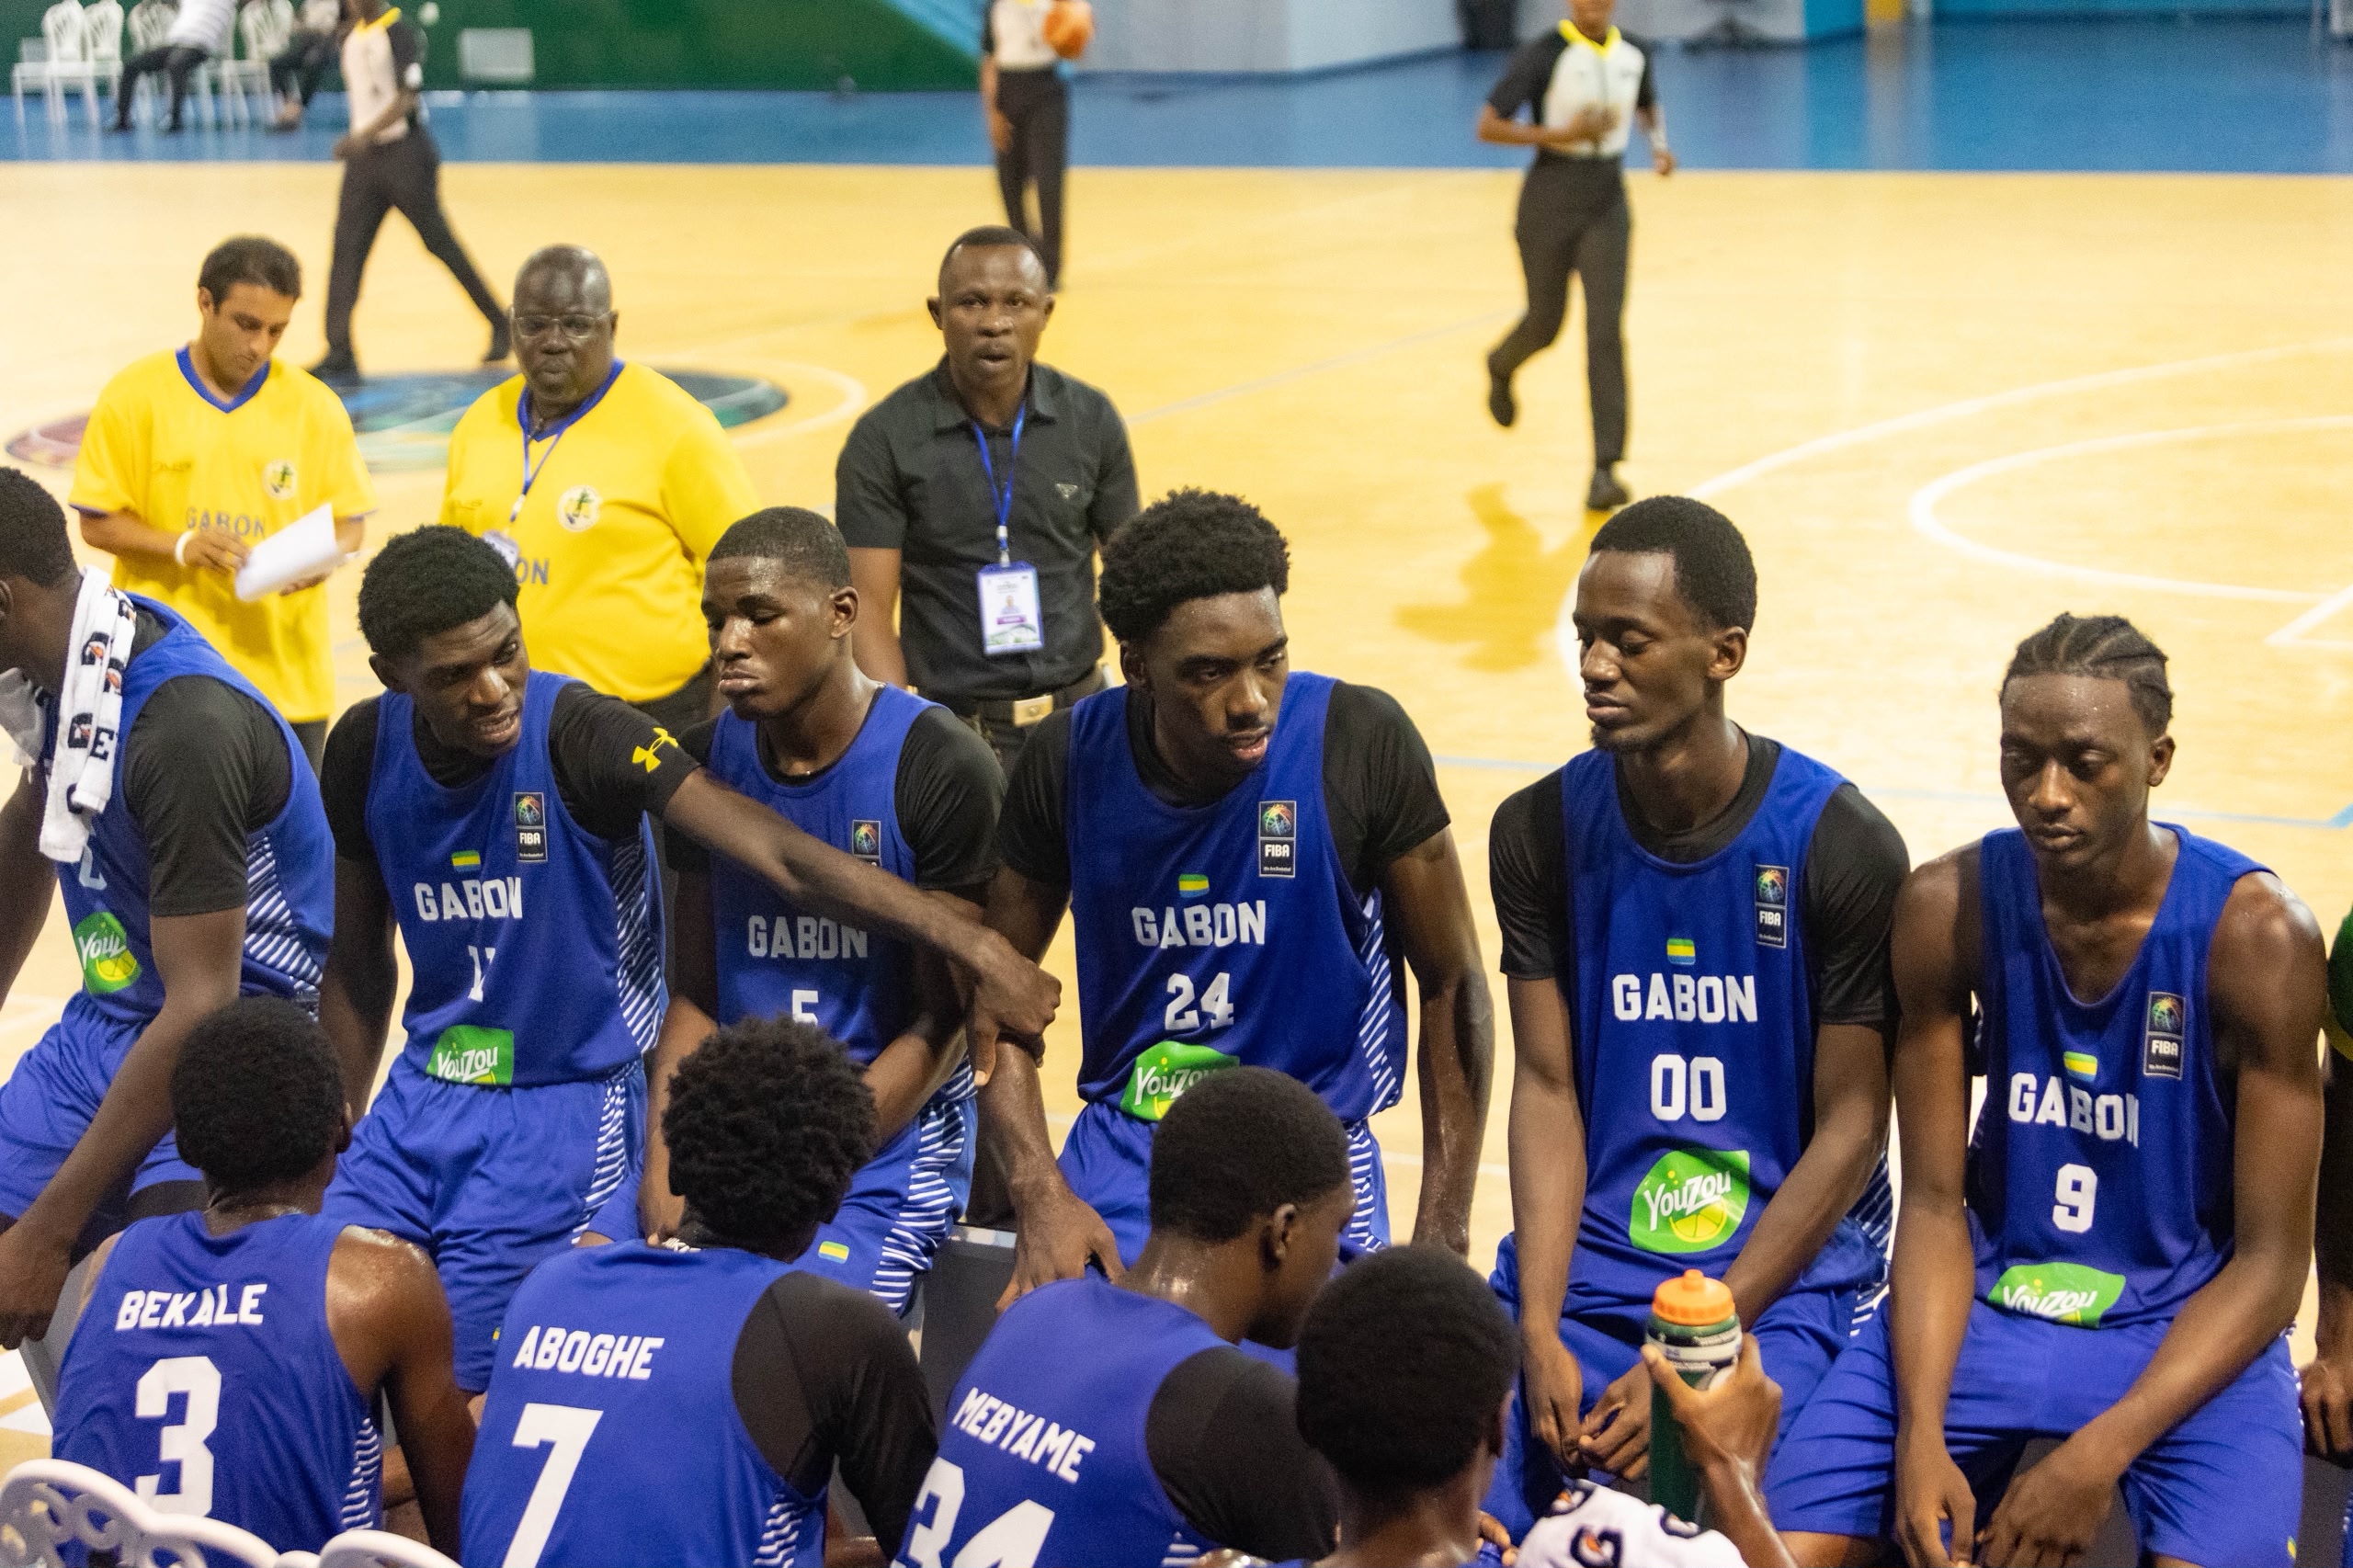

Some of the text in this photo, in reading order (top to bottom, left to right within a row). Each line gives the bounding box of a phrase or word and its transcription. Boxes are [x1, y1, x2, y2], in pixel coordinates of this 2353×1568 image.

[186, 506, 266, 538] GABON
[519, 832, 541, 845] FIBA
[1265, 844, 1290, 858] FIBA
[414, 877, 523, 921] GABON
[1759, 910, 1781, 926] FIBA
[748, 915, 869, 960] GABON
[1131, 900, 1266, 949] GABON
[791, 989, 819, 1026] 5
[1165, 971, 1234, 1030] 24
[1612, 972, 1758, 1023] GABON
[2152, 1040, 2178, 1056] FIBA
[1134, 1065, 1211, 1106] YouZo
[1651, 1053, 1727, 1121] 00
[2008, 1072, 2139, 1149] GABON
[2052, 1163, 2097, 1233] 9
[115, 1283, 267, 1331] BEKALE
[513, 1325, 665, 1380] ABOGHE
[135, 1356, 222, 1520] 3
[952, 1386, 1096, 1484] MEBYAME
[501, 1403, 604, 1568] 7
